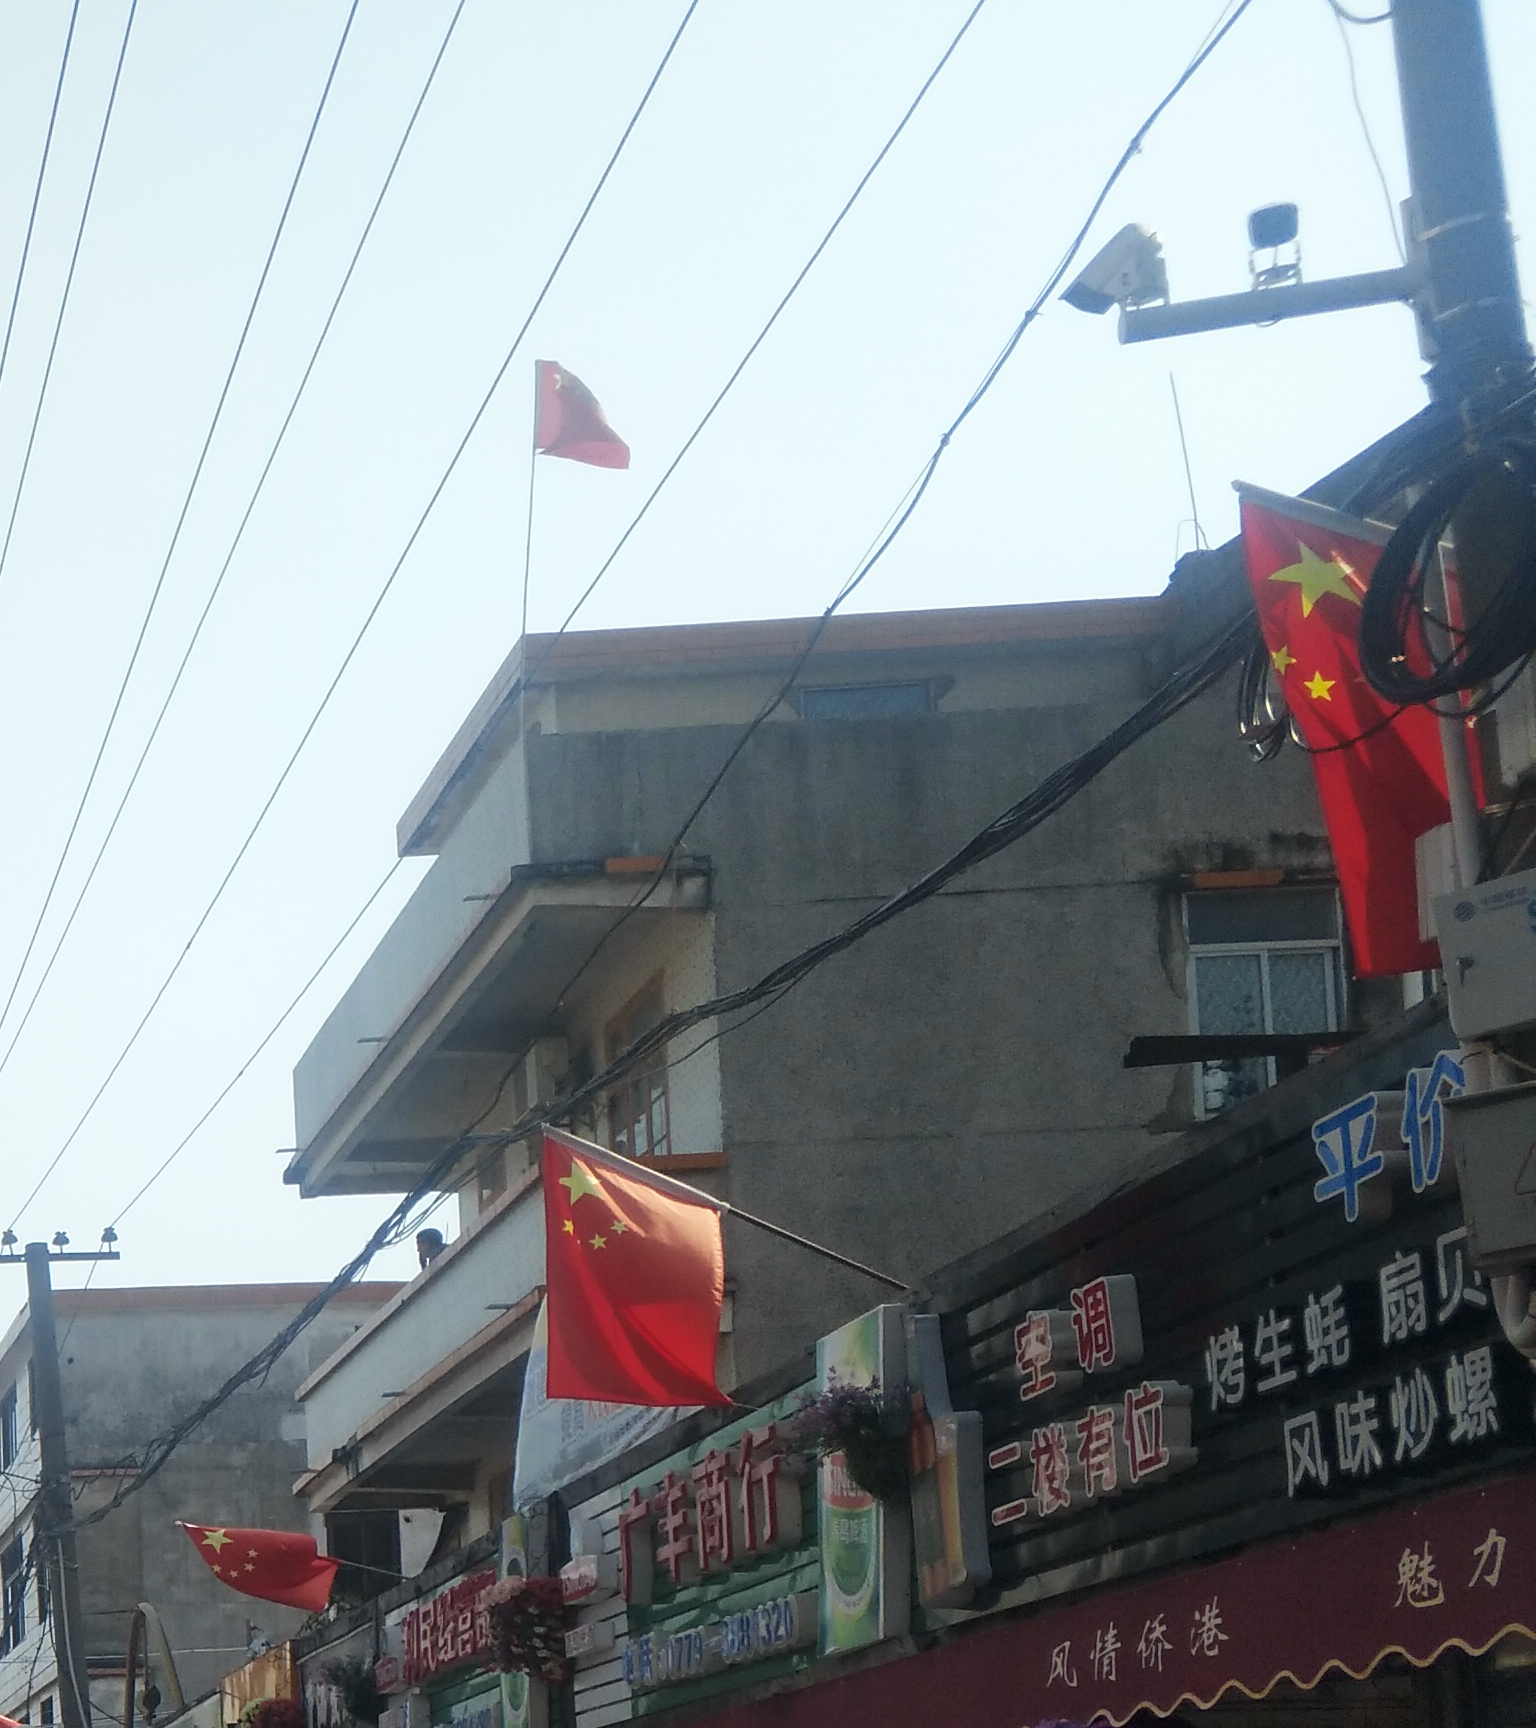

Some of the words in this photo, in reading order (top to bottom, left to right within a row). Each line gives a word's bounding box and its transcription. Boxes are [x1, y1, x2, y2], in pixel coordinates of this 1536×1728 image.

[1014, 1275, 1116, 1401] 空调
[1205, 1285, 1351, 1411] 烤生蚝
[1379, 1227, 1488, 1345] 扇贝
[988, 1379, 1171, 1527] 二楼有位
[1283, 1345, 1500, 1498] 风味炒螺
[618, 1421, 782, 1604] 广丰商行
[1046, 1594, 1230, 1689] 风情侨港
